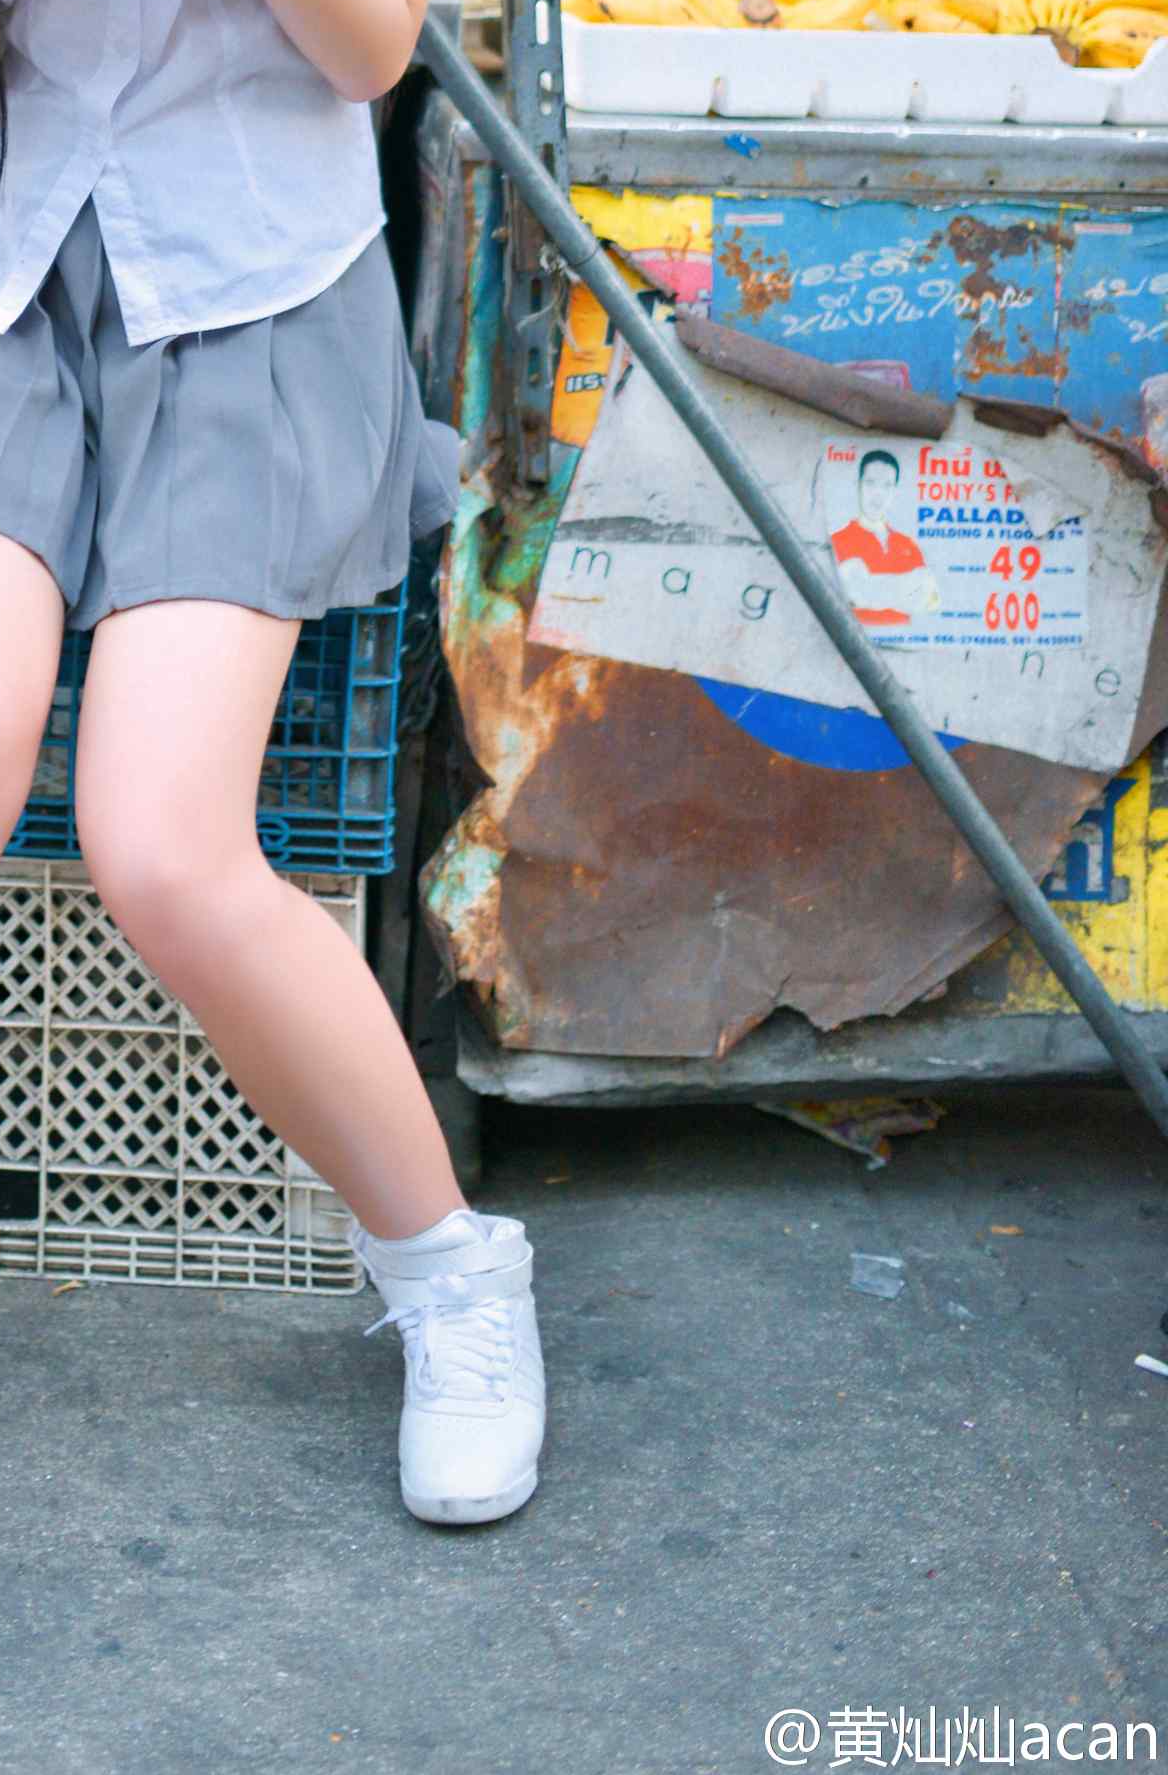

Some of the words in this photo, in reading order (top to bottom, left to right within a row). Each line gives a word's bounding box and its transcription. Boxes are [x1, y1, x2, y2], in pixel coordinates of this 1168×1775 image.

[918, 482, 996, 502] TONY'S
[918, 527, 982, 540] BUILDING
[987, 527, 996, 540] A
[1000, 528, 1037, 541] FLOO
[989, 544, 1042, 582] 49
[984, 591, 1040, 631] 600
